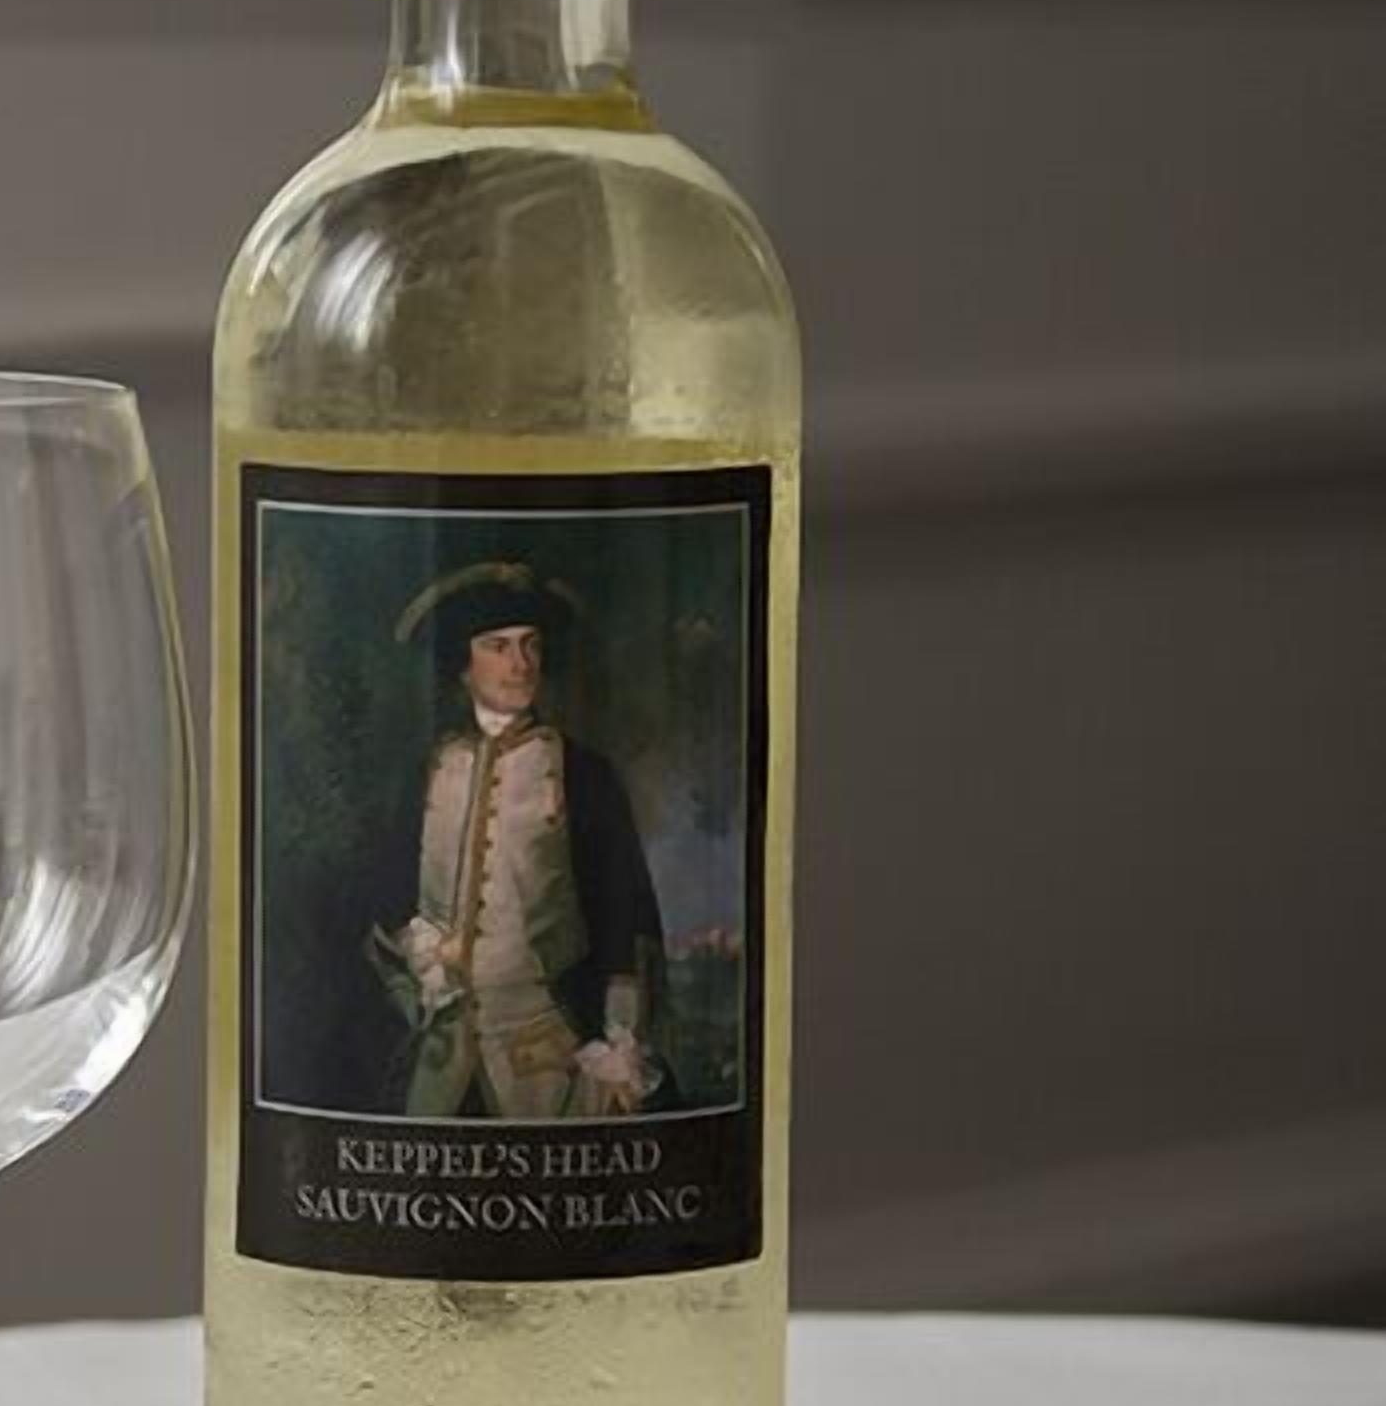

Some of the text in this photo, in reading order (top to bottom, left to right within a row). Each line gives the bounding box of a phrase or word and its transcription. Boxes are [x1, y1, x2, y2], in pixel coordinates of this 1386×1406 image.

[336, 1137, 662, 1179] KEPPEL'S HEAD
[296, 1185, 702, 1231] SAUVIGNON BLANC
